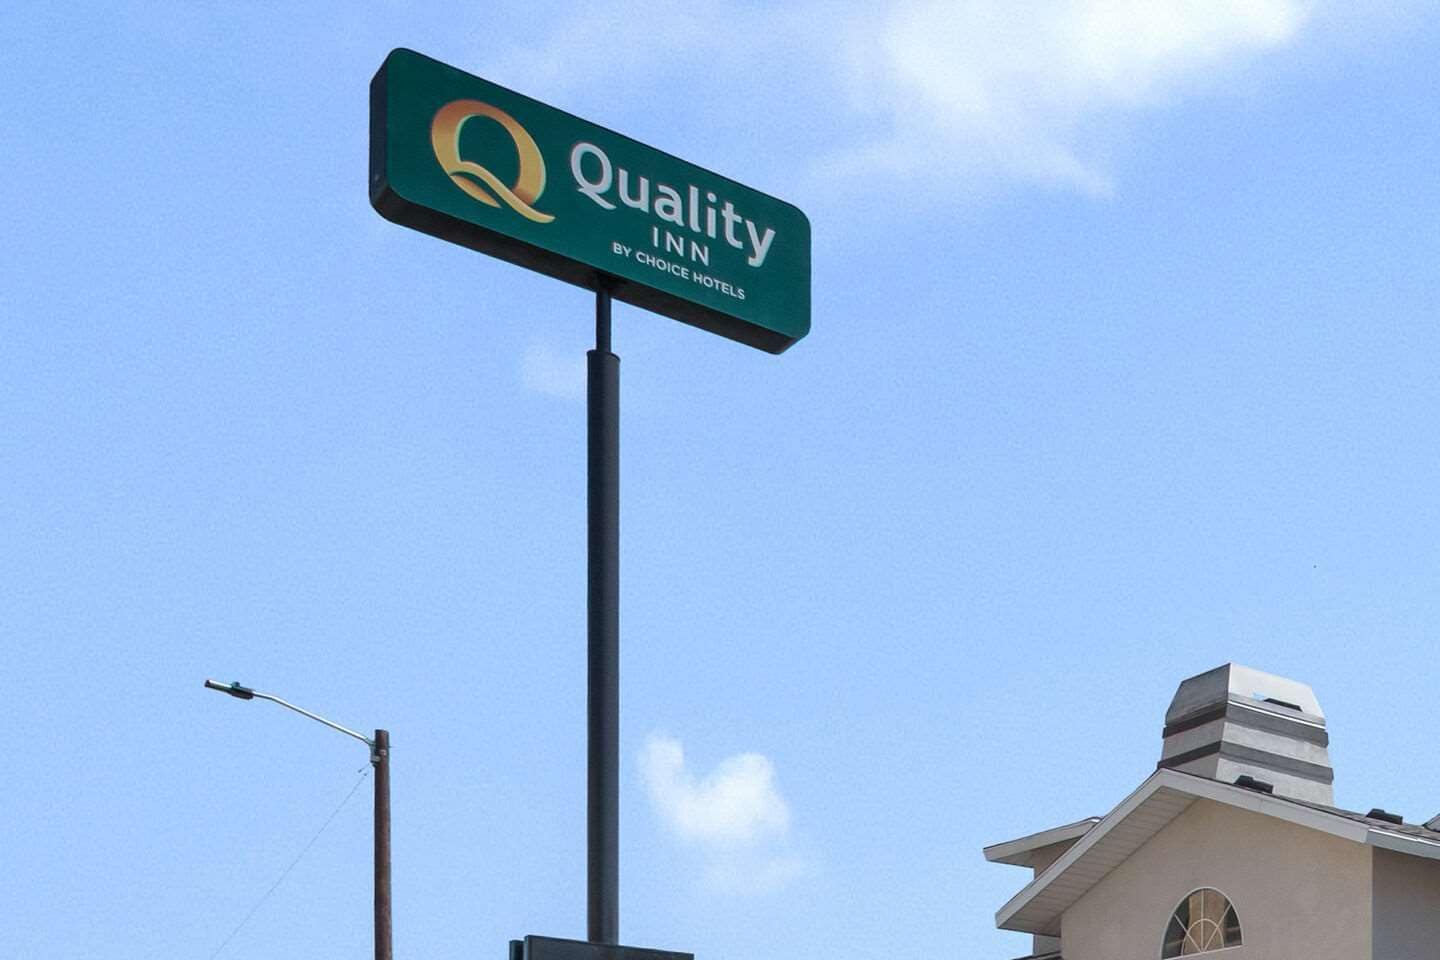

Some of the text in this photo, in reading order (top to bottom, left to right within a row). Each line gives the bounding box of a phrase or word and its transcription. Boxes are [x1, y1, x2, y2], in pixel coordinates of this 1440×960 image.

[431, 100, 555, 223] Q
[570, 142, 776, 267] Quality
[612, 241, 746, 300] BY CHOICE HOTELS
[653, 227, 709, 267] INN
